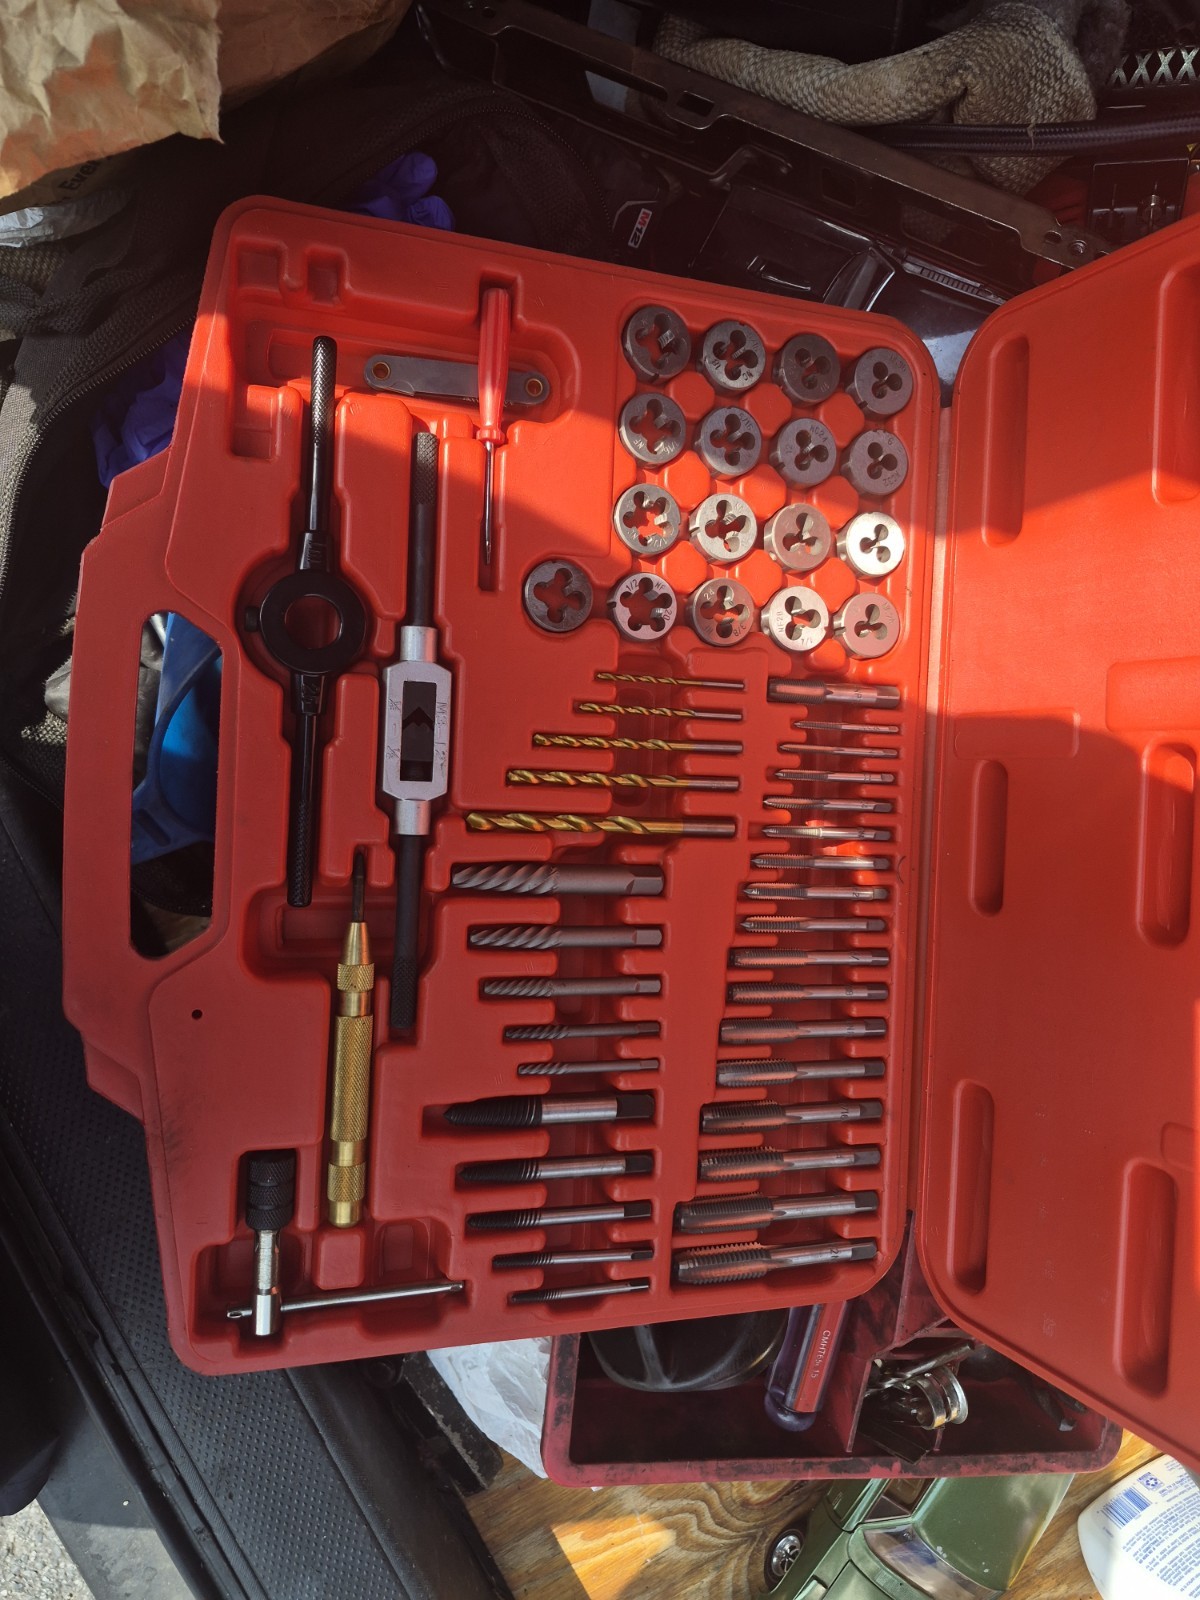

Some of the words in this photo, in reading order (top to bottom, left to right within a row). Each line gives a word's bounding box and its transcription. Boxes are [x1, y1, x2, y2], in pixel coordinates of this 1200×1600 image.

[630, 211, 651, 246] M12
[625, 578, 640, 593] 1/2
[654, 581, 667, 591] NF
[703, 590, 716, 601] 24
[662, 608, 673, 622] 20
